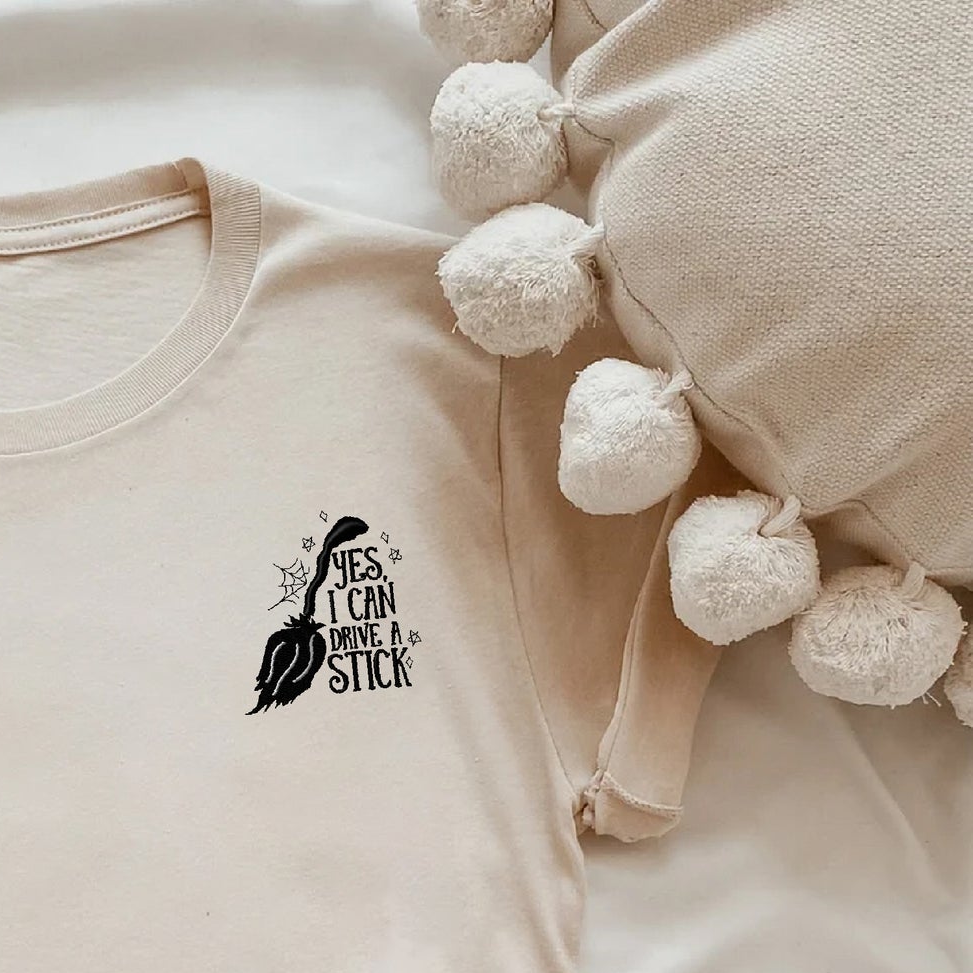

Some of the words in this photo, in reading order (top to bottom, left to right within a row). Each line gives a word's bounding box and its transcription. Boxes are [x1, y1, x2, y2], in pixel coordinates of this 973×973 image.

[331, 547, 388, 589] YES,
[327, 590, 337, 623] I
[347, 582, 396, 621] CAN
[329, 622, 383, 651] DRIVE
[390, 621, 402, 645] A
[327, 647, 412, 693] STICK
